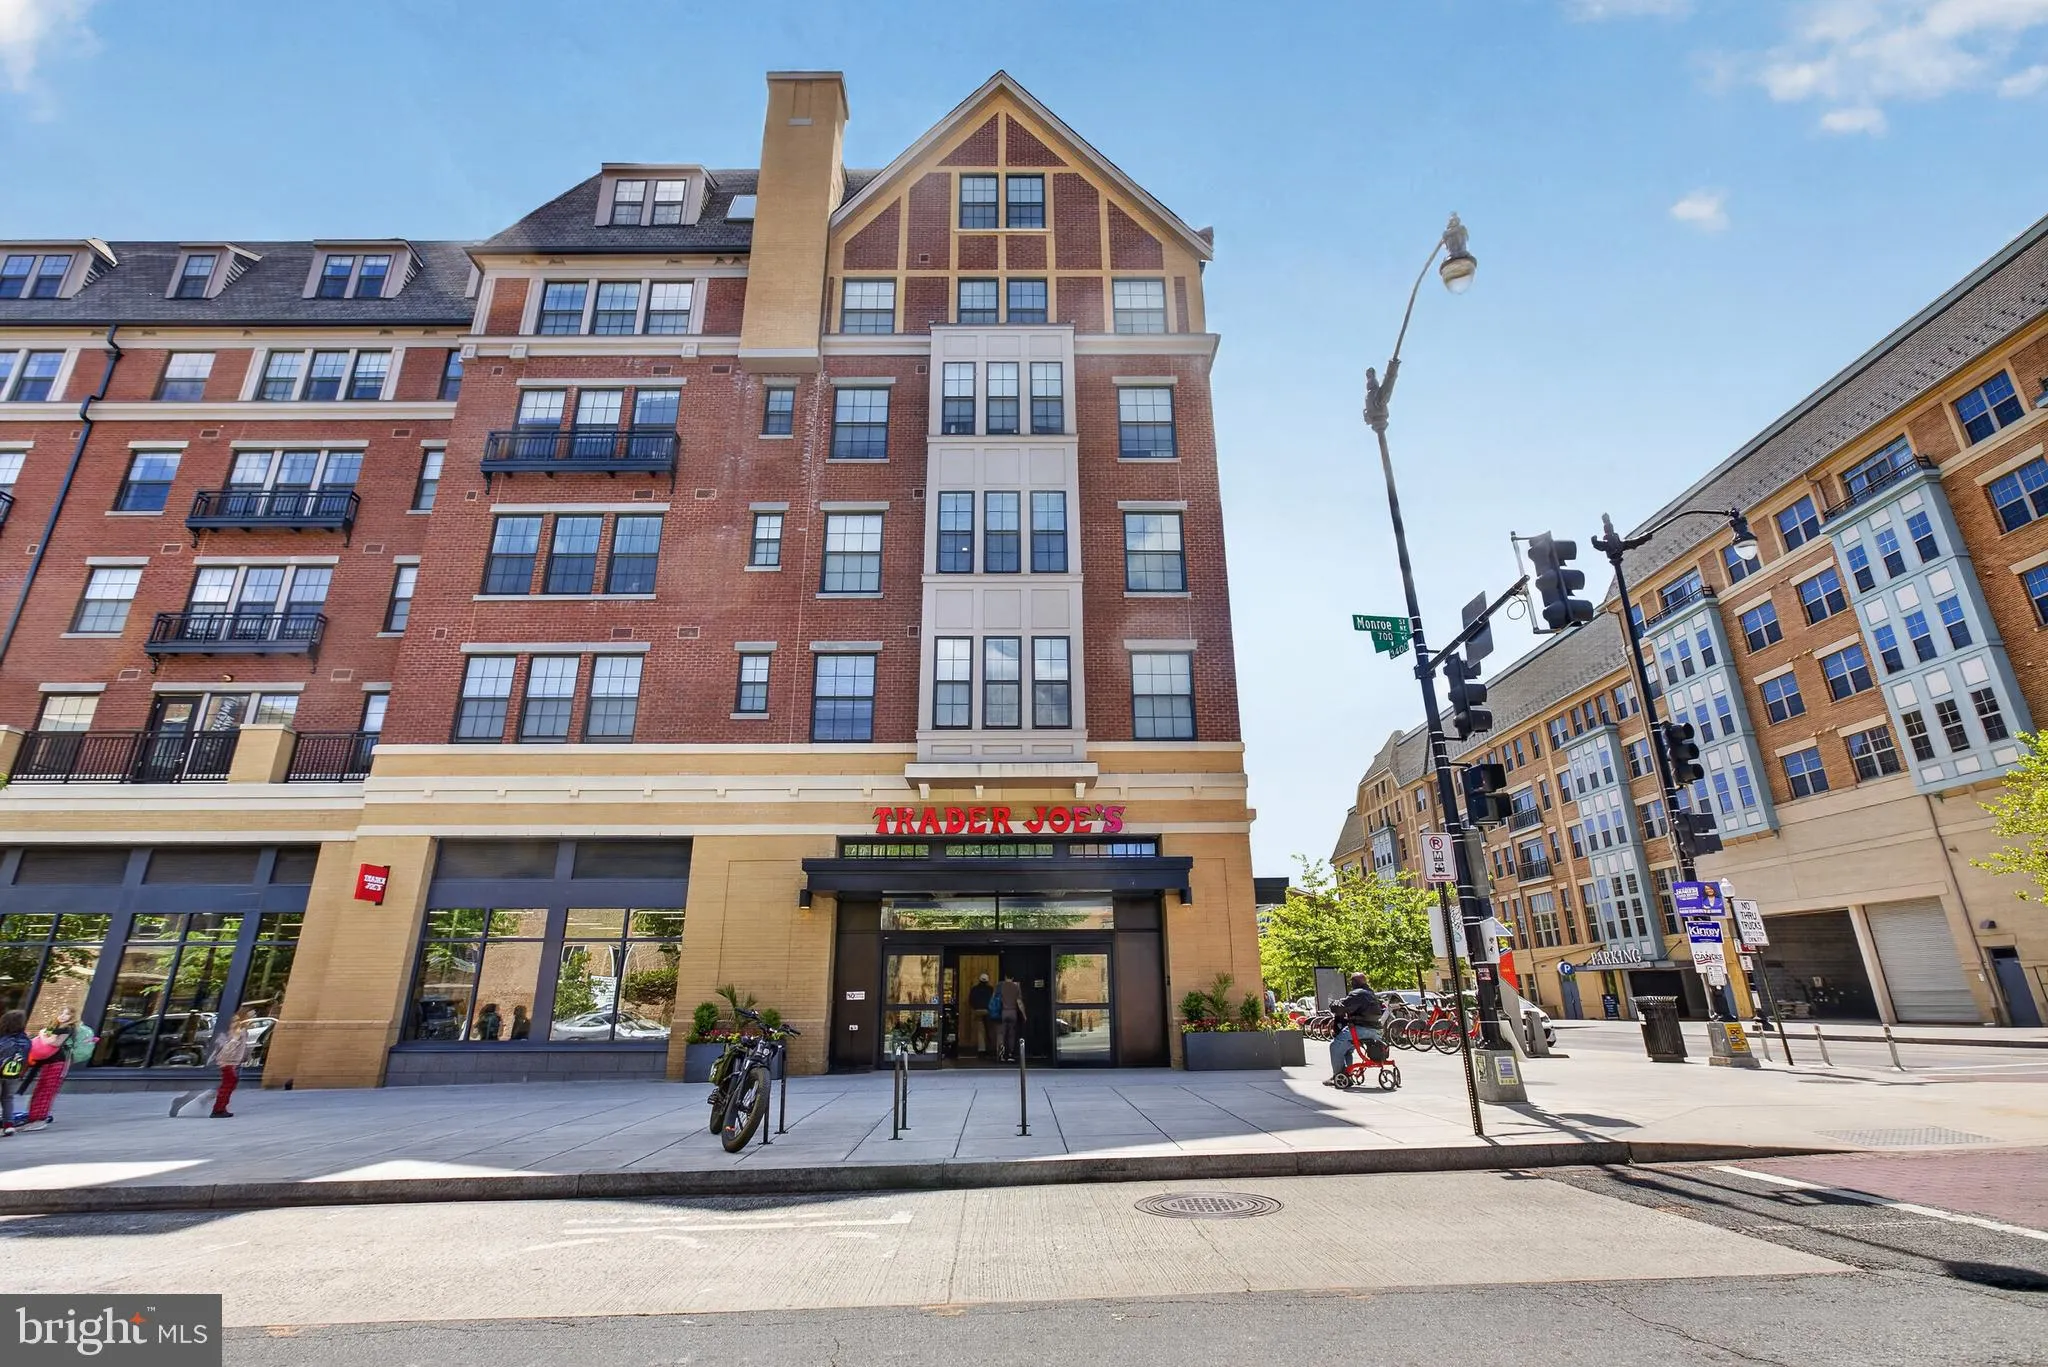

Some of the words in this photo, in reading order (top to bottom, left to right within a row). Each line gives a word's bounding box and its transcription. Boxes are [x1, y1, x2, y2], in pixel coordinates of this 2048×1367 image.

[1356, 616, 1392, 630] Monroe
[1377, 632, 1394, 641] 700
[872, 807, 1013, 834] TRADER
[1022, 804, 1126, 834] JOE'S
[1741, 901, 1751, 911] NO
[1740, 911, 1757, 920] THRU
[1741, 921, 1762, 930] TRUCKS
[1591, 949, 1641, 965] PARKING
